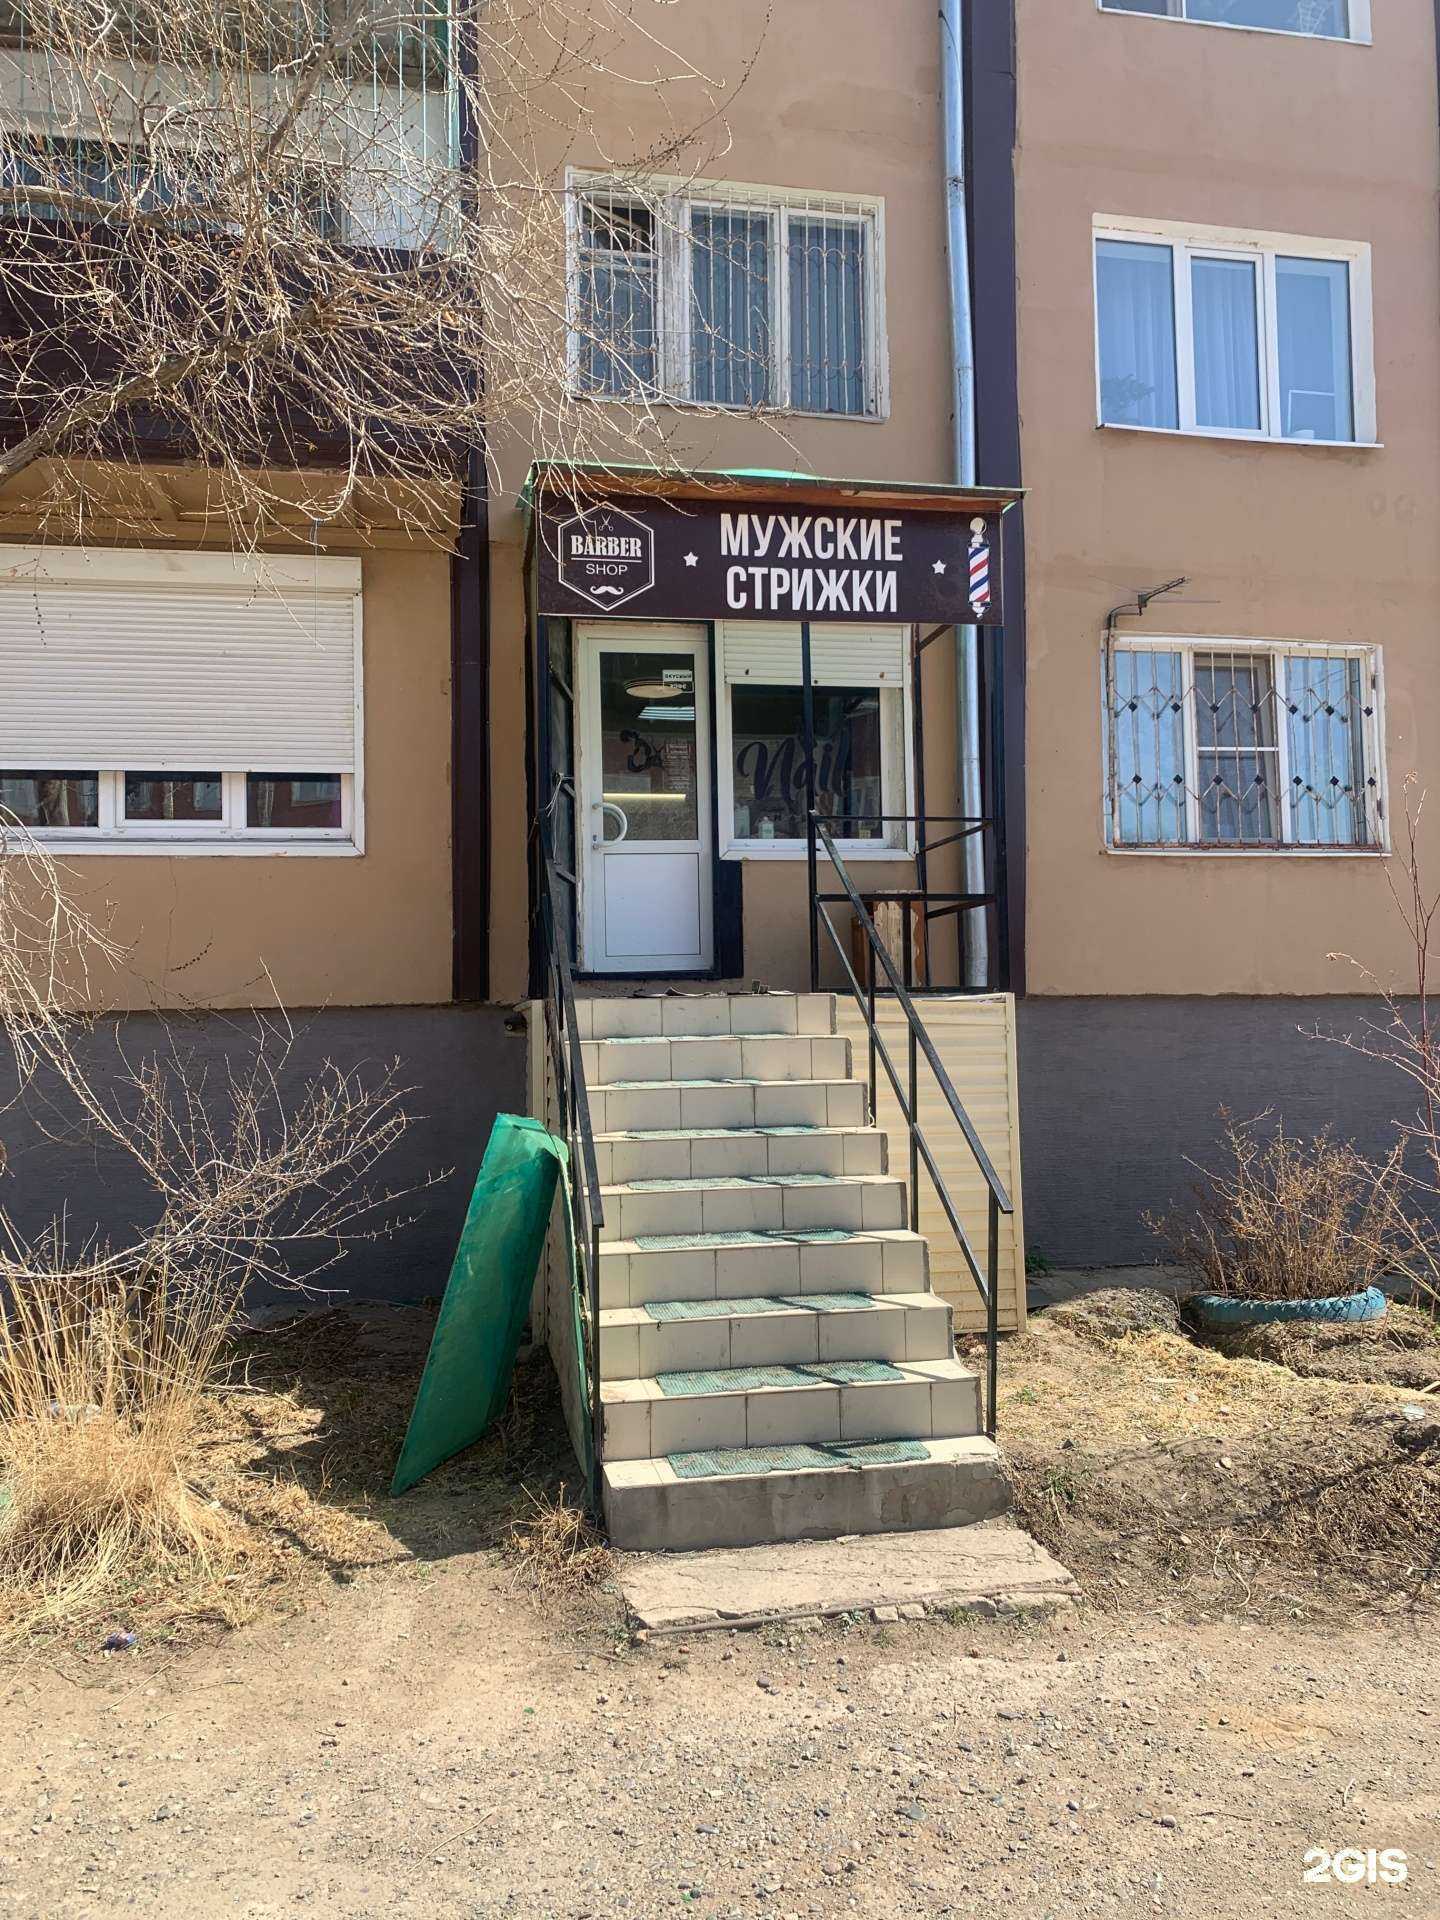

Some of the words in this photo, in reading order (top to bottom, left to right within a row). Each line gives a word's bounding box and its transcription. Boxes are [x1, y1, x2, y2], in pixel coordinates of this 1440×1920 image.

[570, 534, 642, 558] BARBER
[720, 513, 903, 562] МУЖСКИЕ
[585, 562, 628, 577] SHOP
[726, 565, 898, 613] СТРИЖКИ
